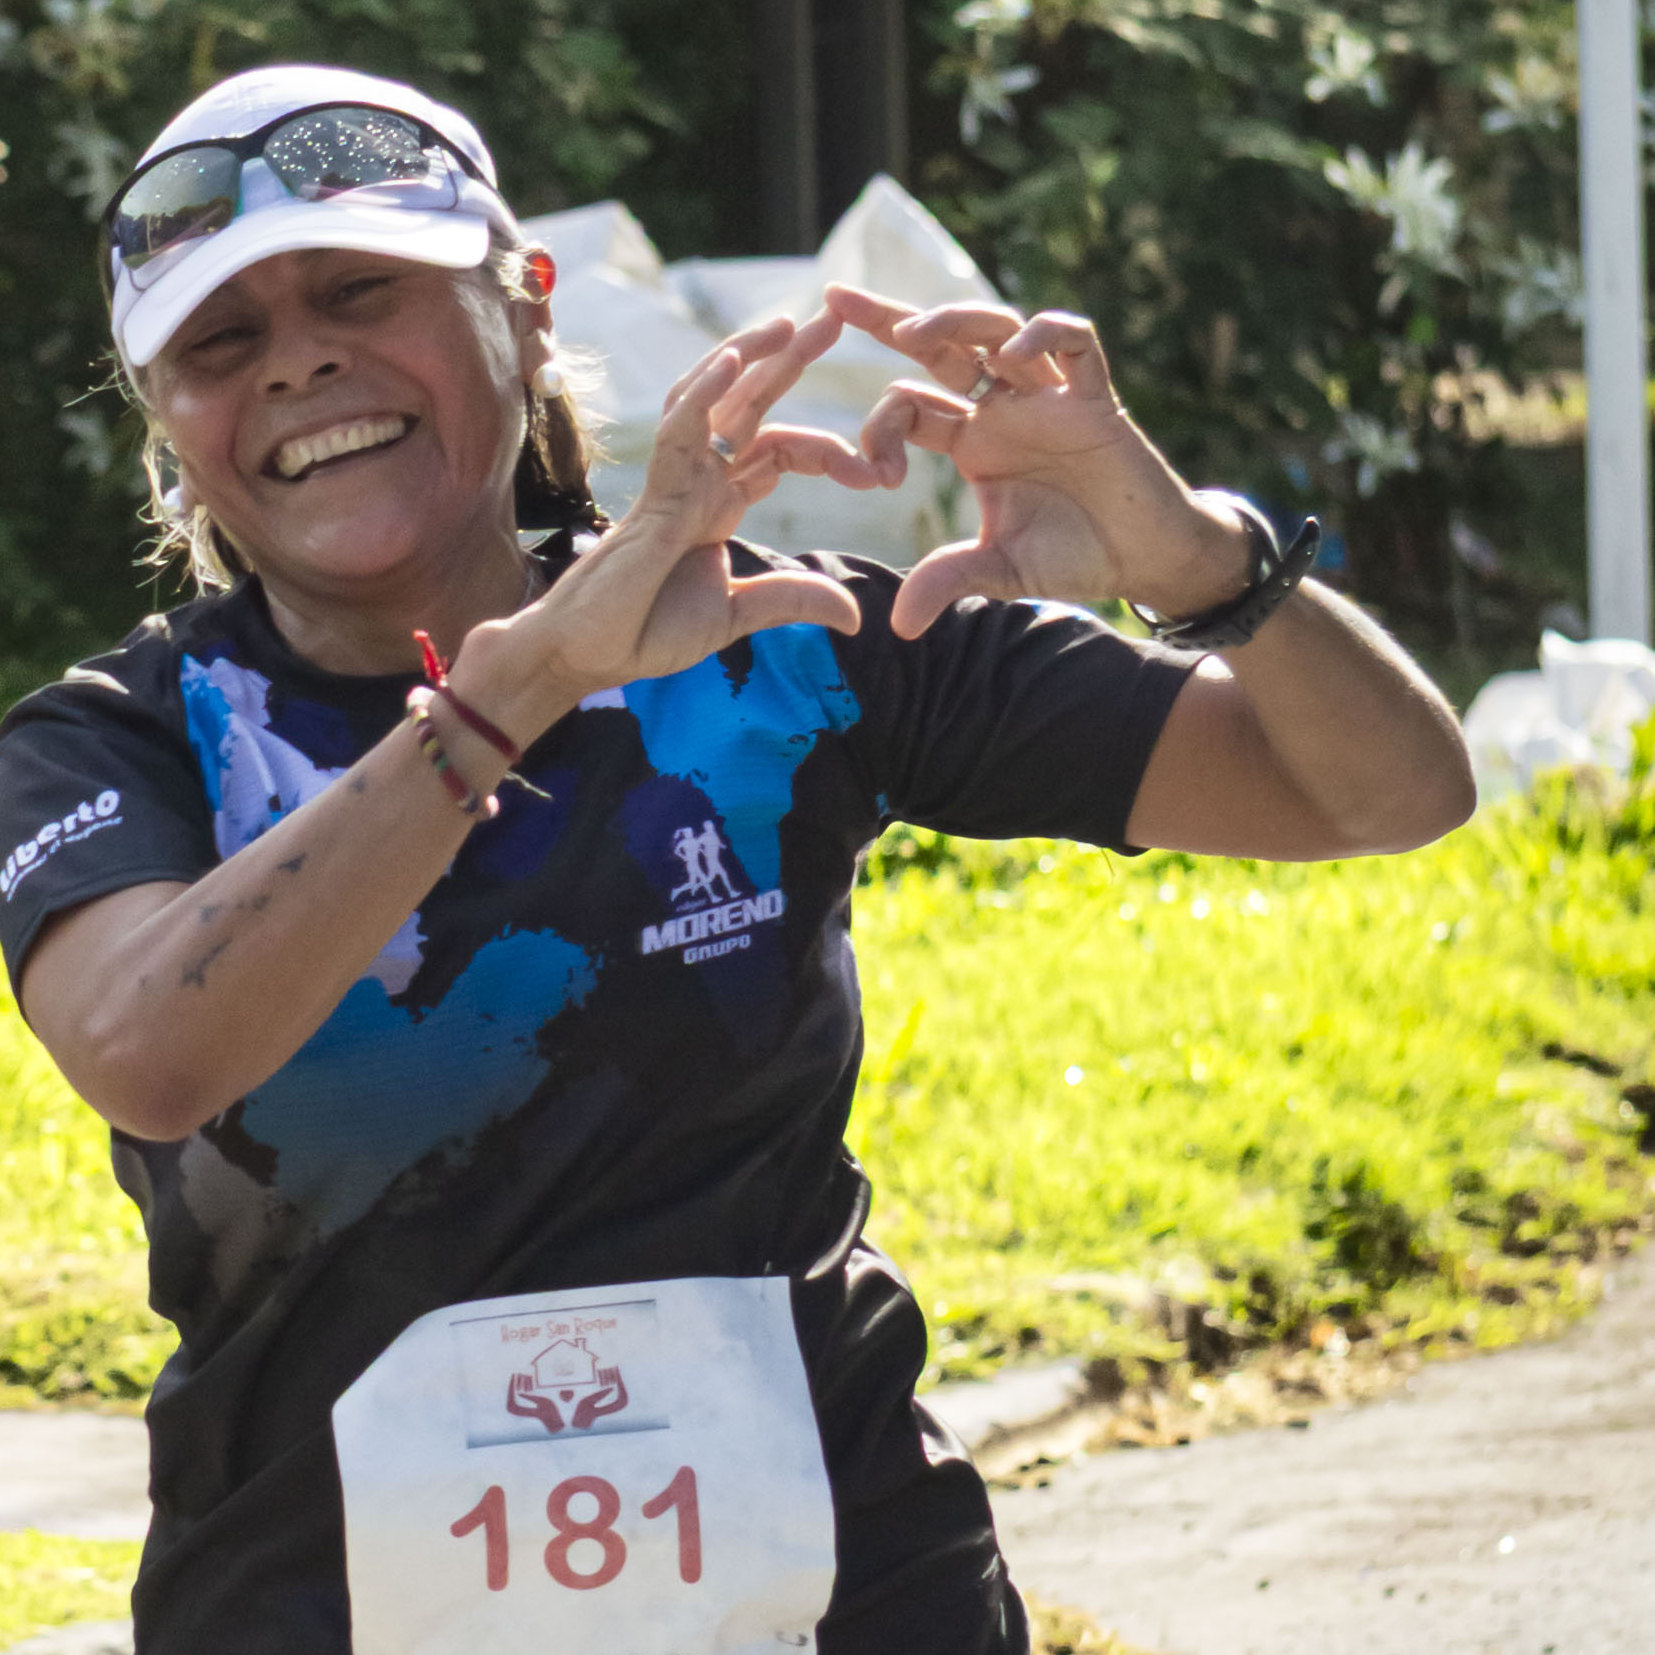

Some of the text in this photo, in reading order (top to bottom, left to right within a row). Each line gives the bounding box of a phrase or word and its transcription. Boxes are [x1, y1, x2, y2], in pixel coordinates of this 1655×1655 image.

[641, 889, 784, 955] MORENO
[546, 1319, 570, 1339] San
[449, 1465, 703, 1592] 181
